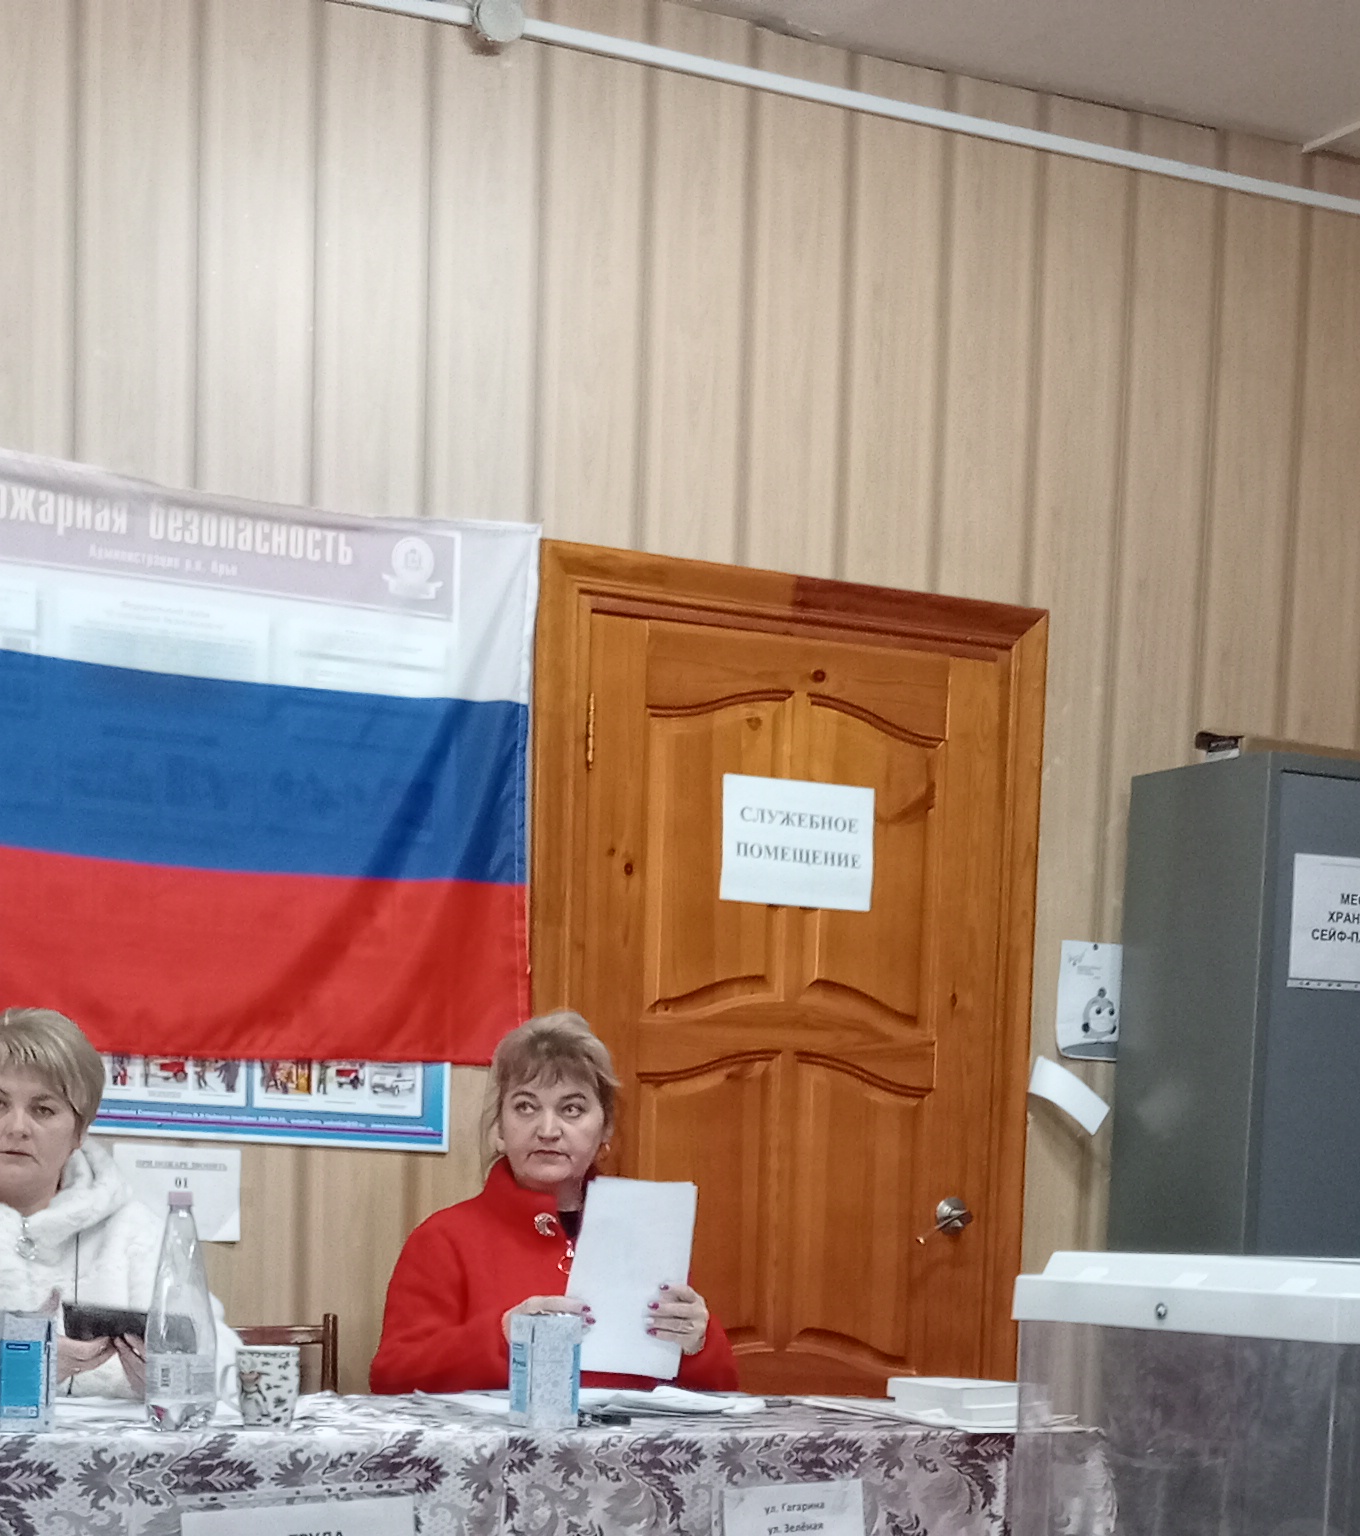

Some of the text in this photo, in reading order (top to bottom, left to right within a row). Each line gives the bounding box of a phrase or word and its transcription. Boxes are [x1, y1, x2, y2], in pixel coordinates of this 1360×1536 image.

[740, 806, 859, 834] СЛУЖЕБНОЕ
[736, 841, 861, 869] ПОМЕЩЕНИЕ
[174, 1177, 188, 1189] 01
[764, 1501, 825, 1515] ул. Гагарина
